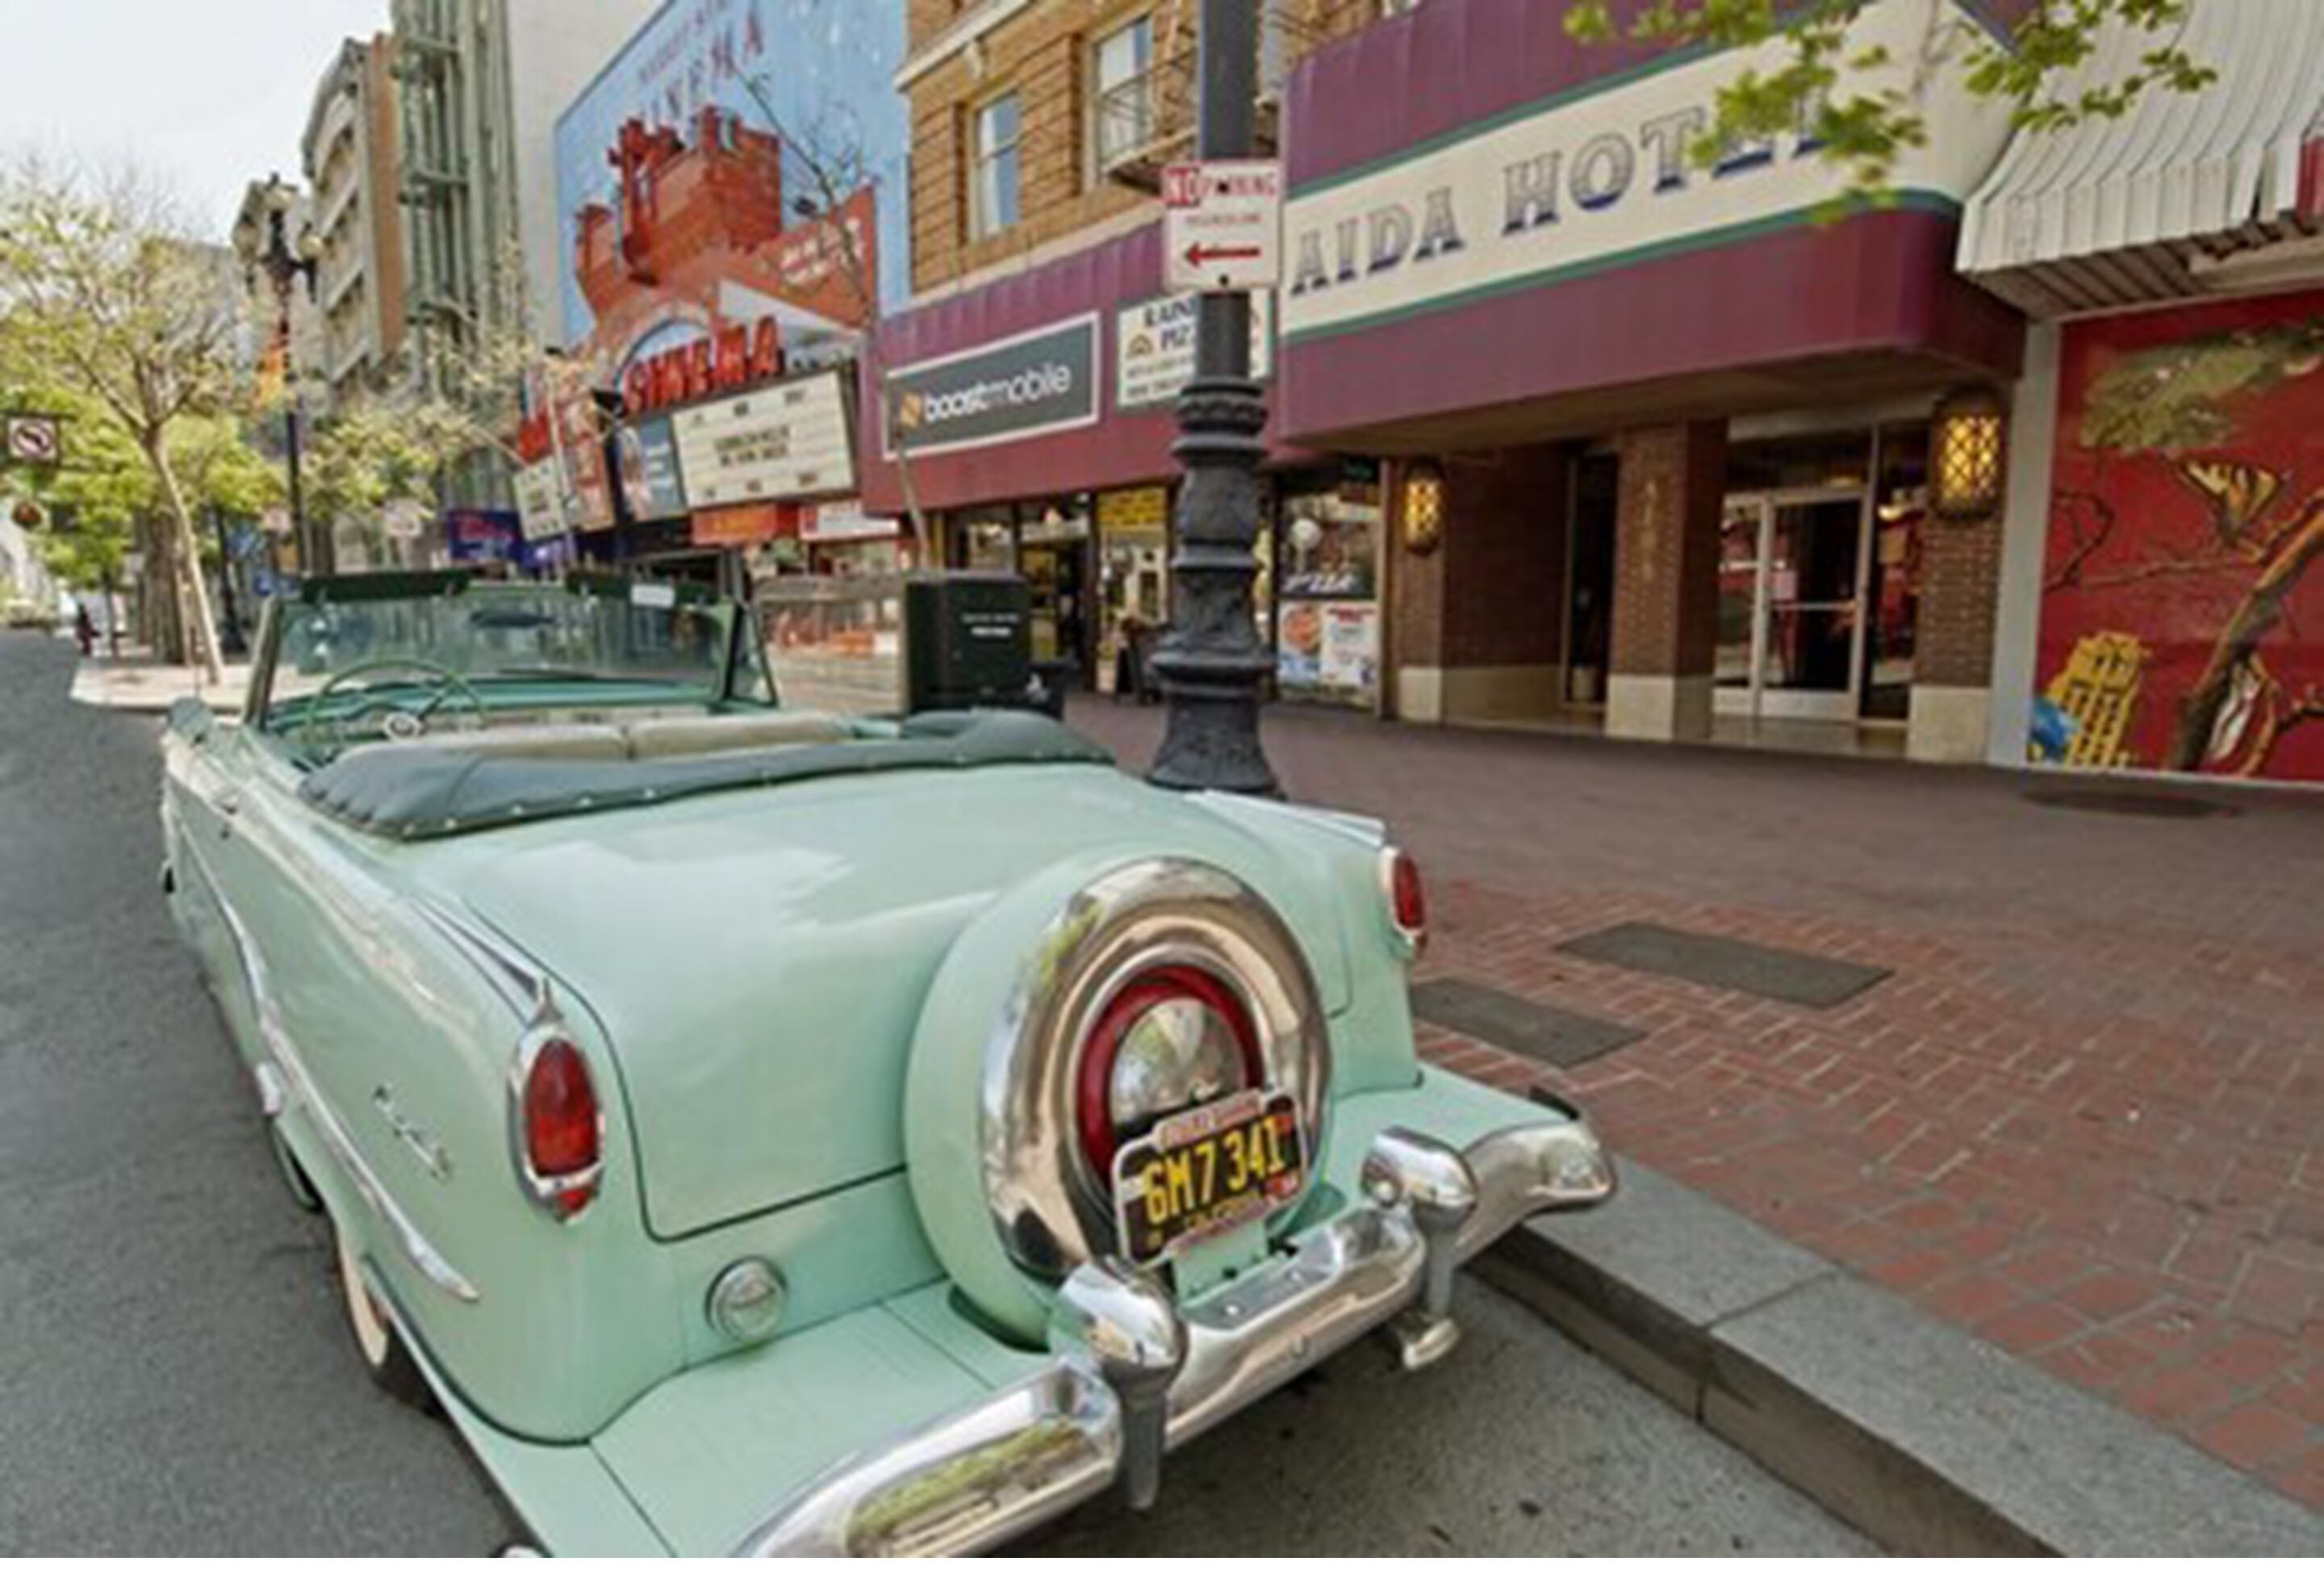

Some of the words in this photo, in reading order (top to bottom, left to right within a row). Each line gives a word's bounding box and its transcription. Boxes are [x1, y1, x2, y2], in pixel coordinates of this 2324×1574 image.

[1289, 186, 1463, 296] AIDA
[1502, 81, 1830, 236] HOT
[1224, 1116, 1285, 1192] 341
